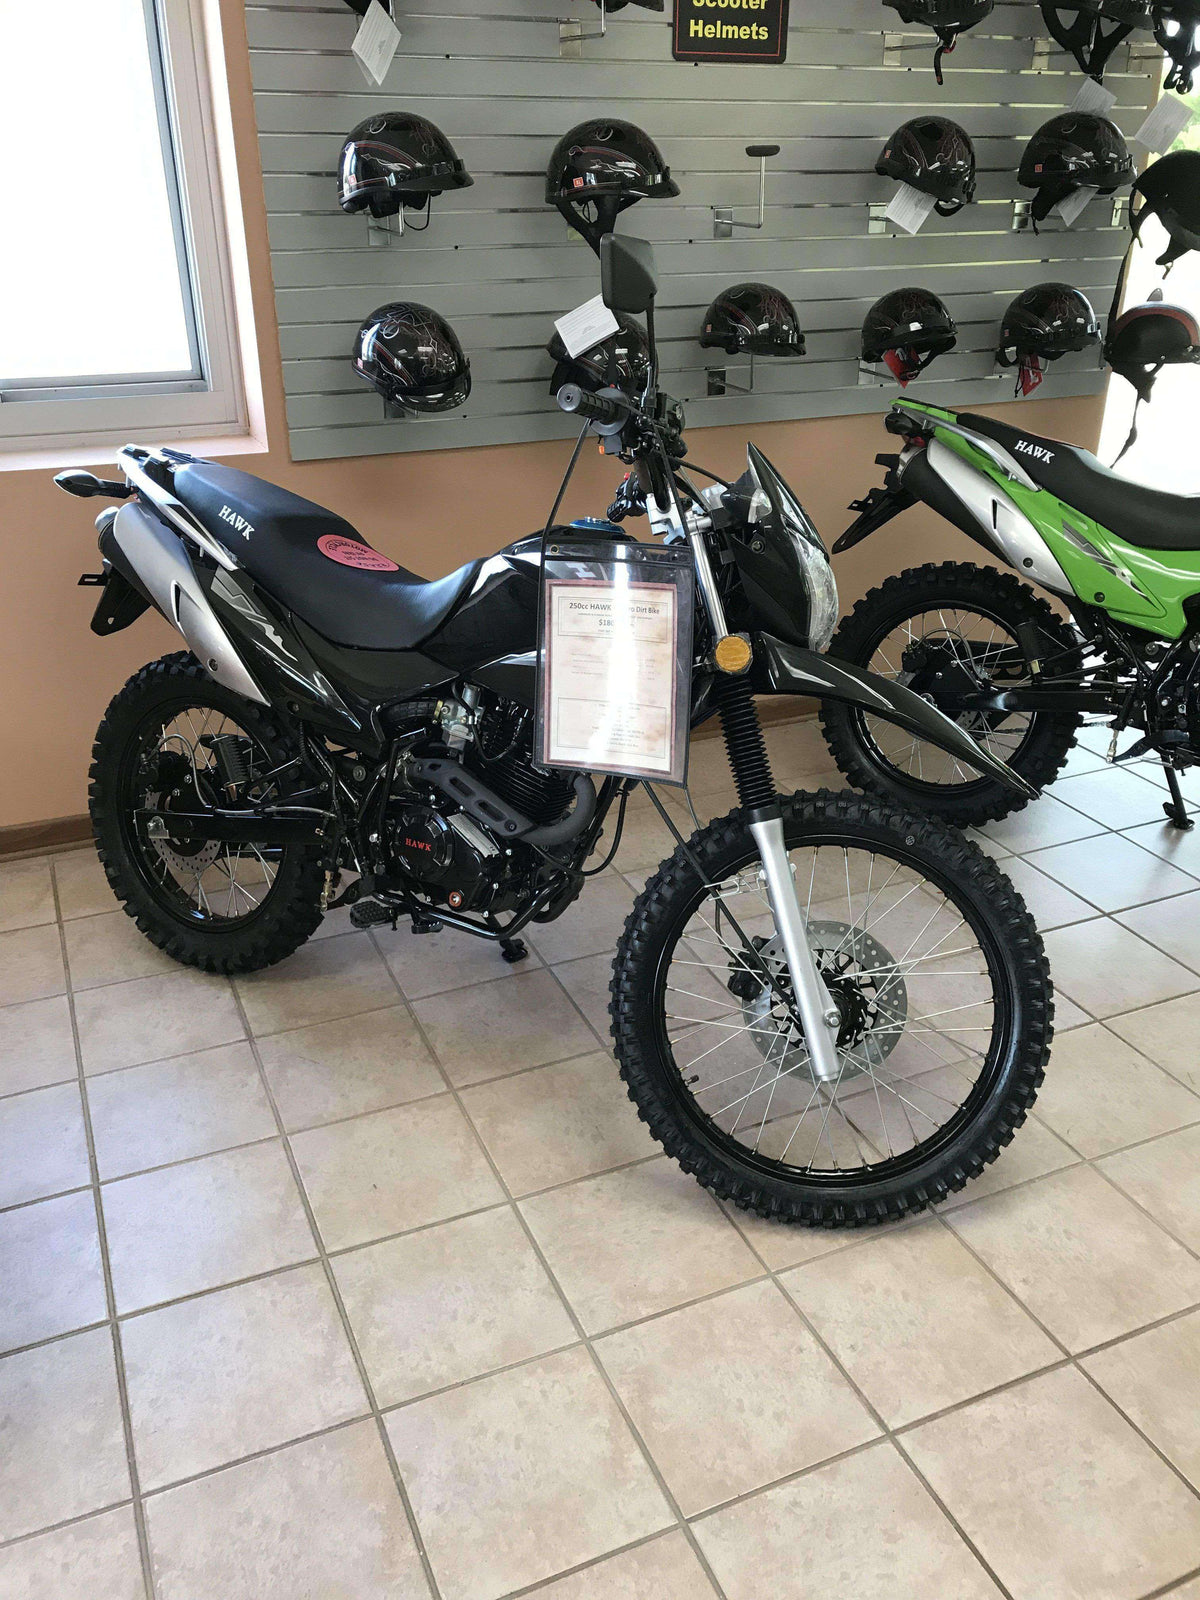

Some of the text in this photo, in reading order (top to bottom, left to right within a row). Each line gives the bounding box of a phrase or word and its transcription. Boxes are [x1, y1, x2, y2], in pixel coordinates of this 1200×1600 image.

[689, 19, 769, 40] Helmets
[1014, 440, 1055, 464] HAWK
[218, 504, 255, 541] HAWK
[569, 602, 589, 610] 250cc
[590, 603, 612, 611] HAWK
[648, 607, 660, 615] Bike
[405, 838, 432, 852] HAWK
